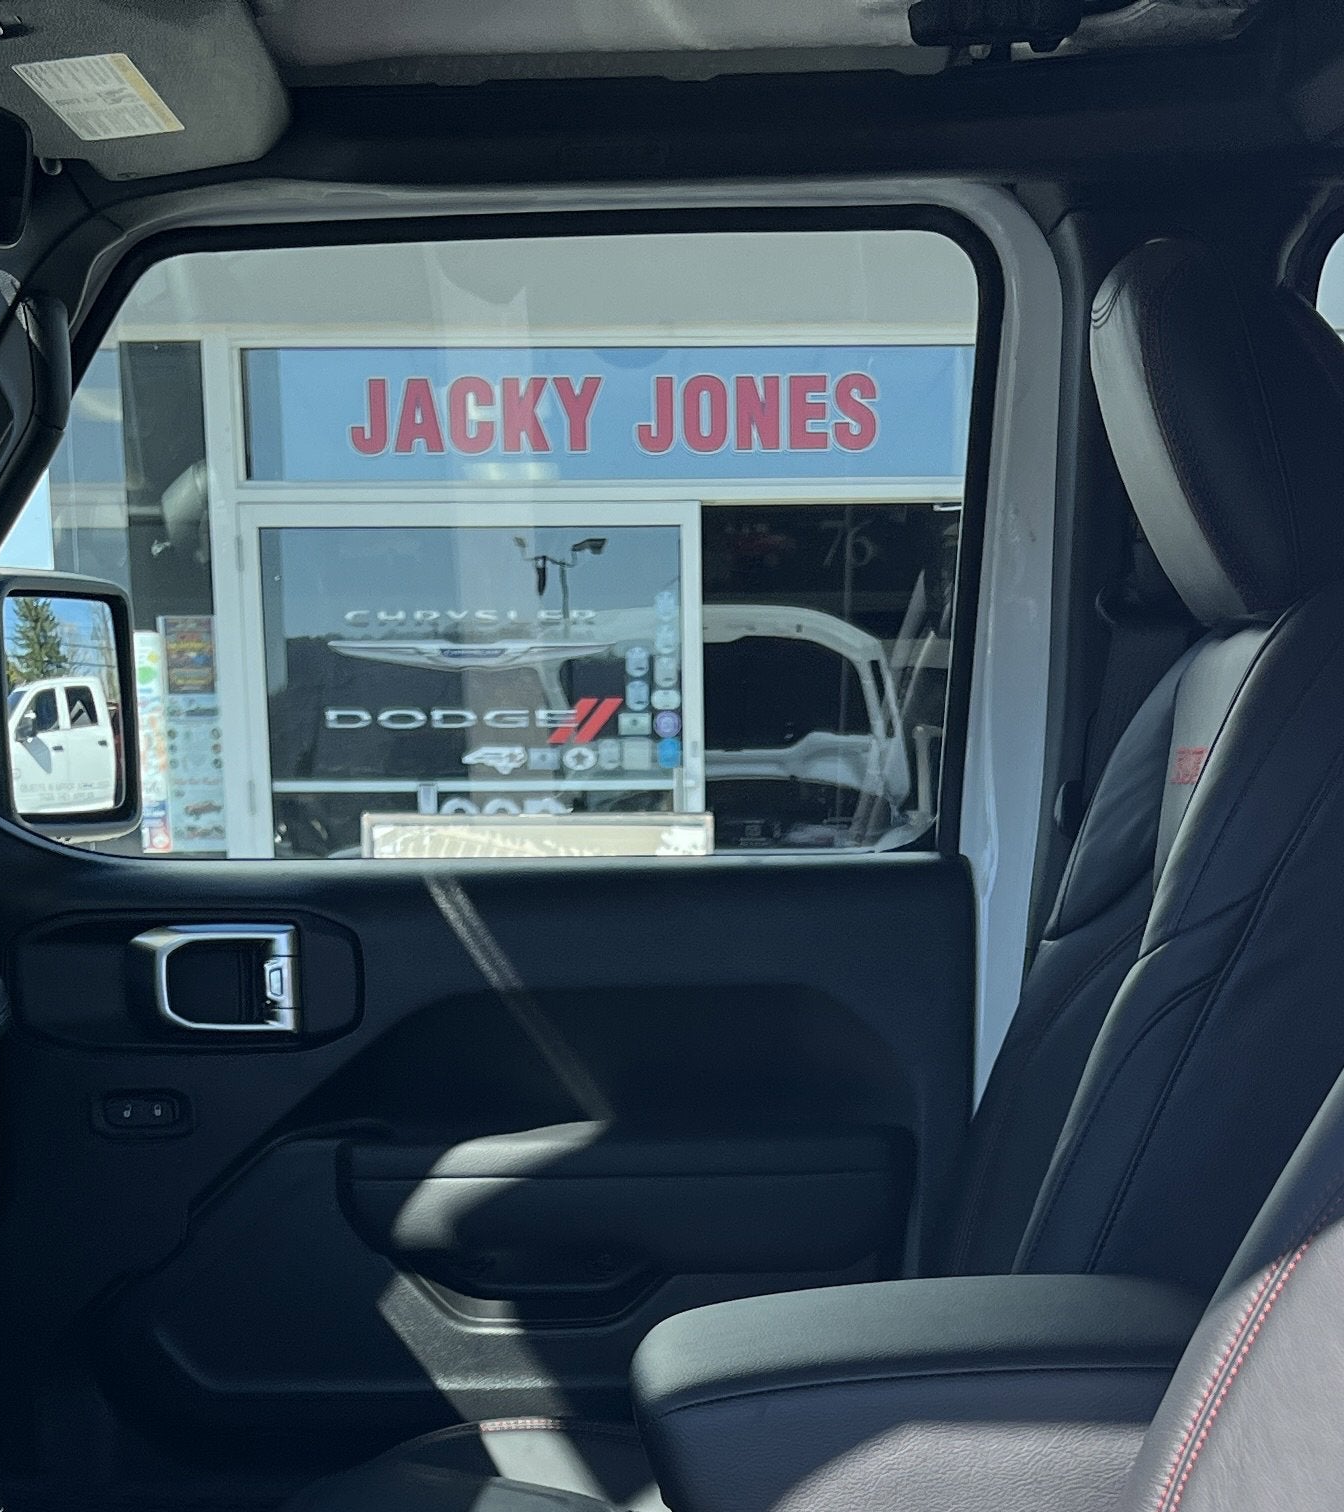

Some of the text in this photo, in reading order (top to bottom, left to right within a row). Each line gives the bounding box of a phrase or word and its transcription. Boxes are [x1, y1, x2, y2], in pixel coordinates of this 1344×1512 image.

[349, 372, 878, 455] JACKY JONES
[344, 609, 597, 624] CHRYSLER
[325, 708, 578, 730] DODGE
